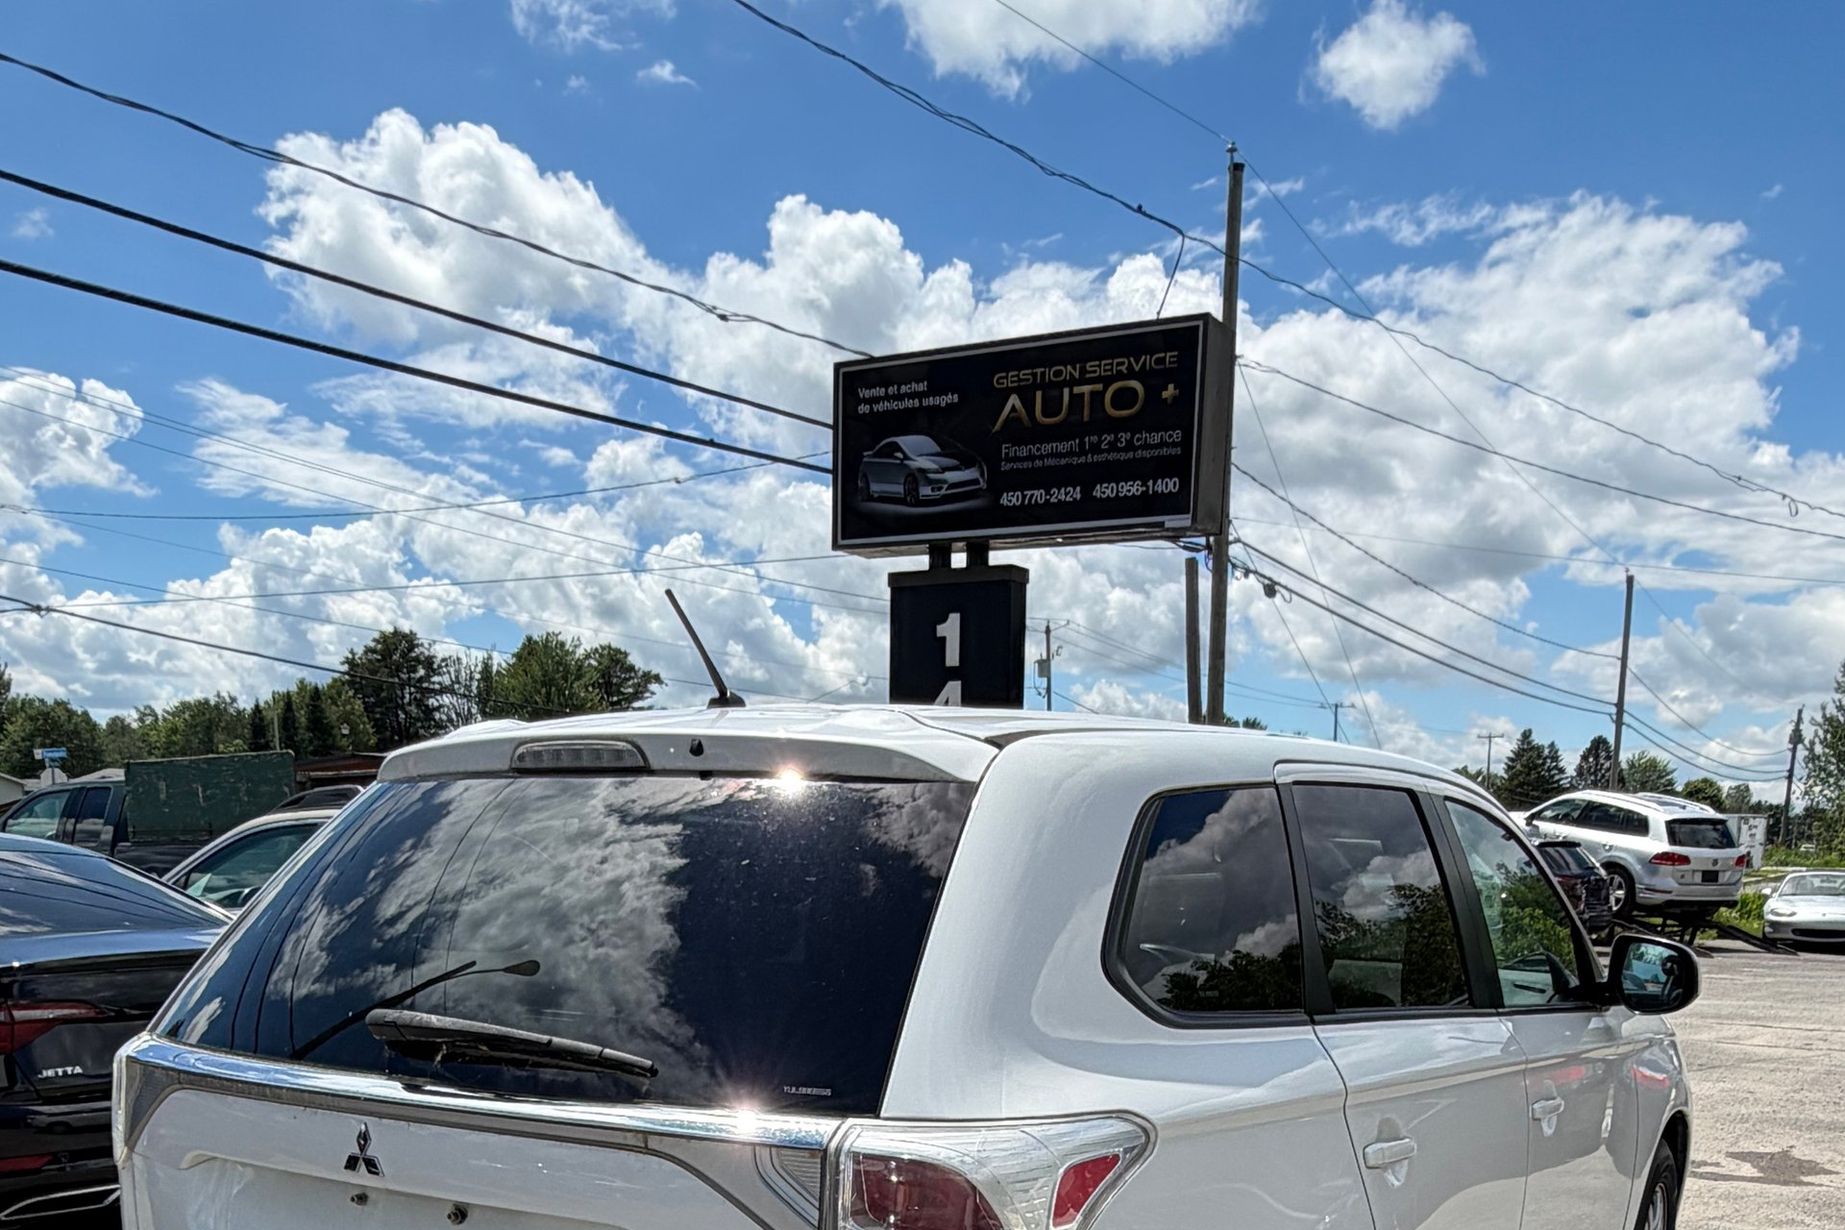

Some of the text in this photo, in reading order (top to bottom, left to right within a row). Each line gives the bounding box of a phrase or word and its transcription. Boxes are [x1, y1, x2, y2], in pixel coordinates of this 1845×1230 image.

[994, 352, 1178, 388] GESTION SERVICE
[858, 381, 927, 398] Vente et achat
[858, 393, 958, 413] de véhicules usagés
[993, 380, 1144, 433] AUTO
[1002, 438, 1079, 459] Financement
[1134, 430, 1181, 446] chance
[1034, 460, 1043, 468] de
[1000, 486, 1081, 506] 450 770-2424
[1093, 477, 1179, 498] 450 956-1400
[936, 612, 961, 667] 1
[37, 1066, 83, 1079] JETTA
